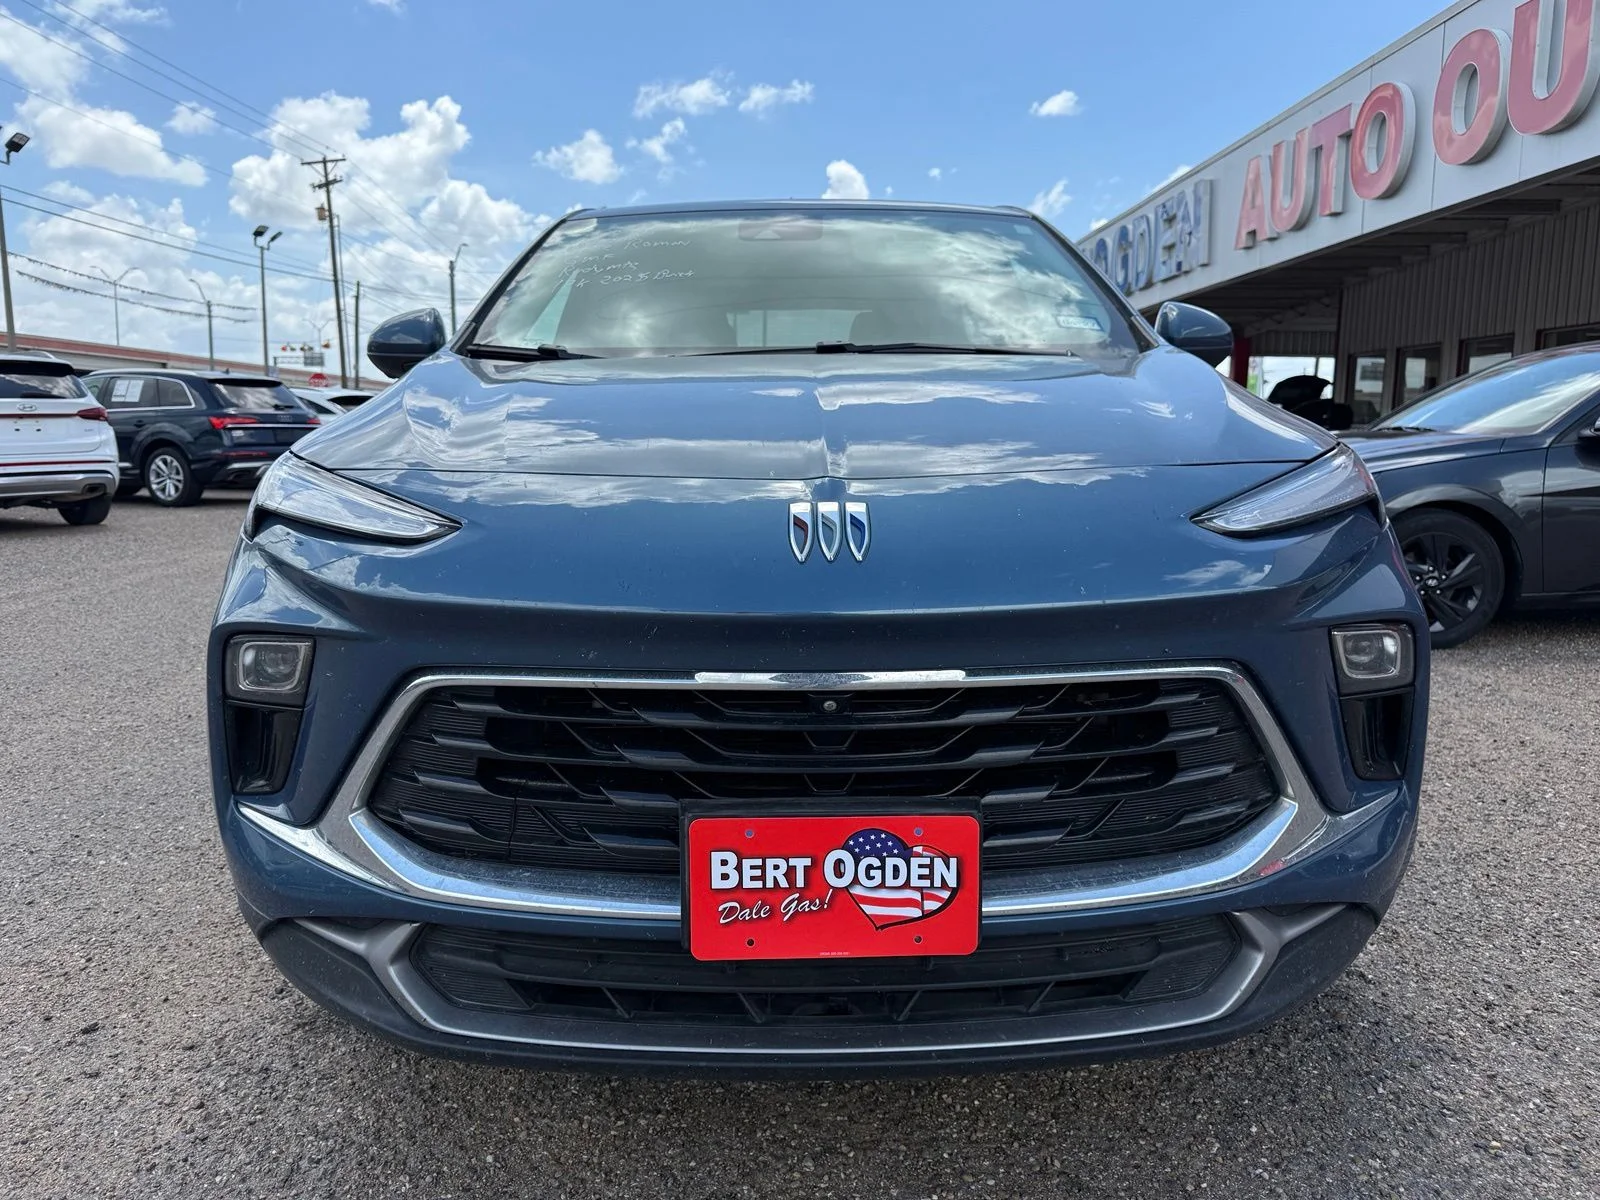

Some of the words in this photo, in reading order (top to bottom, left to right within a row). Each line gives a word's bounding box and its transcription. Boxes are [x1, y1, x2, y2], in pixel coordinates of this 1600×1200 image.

[1234, 81, 1414, 250] AUTO
[709, 850, 812, 890] BERT
[823, 848, 958, 889] OGDEN
[717, 900, 771, 924] Dale
[780, 888, 834, 922] Gas!
